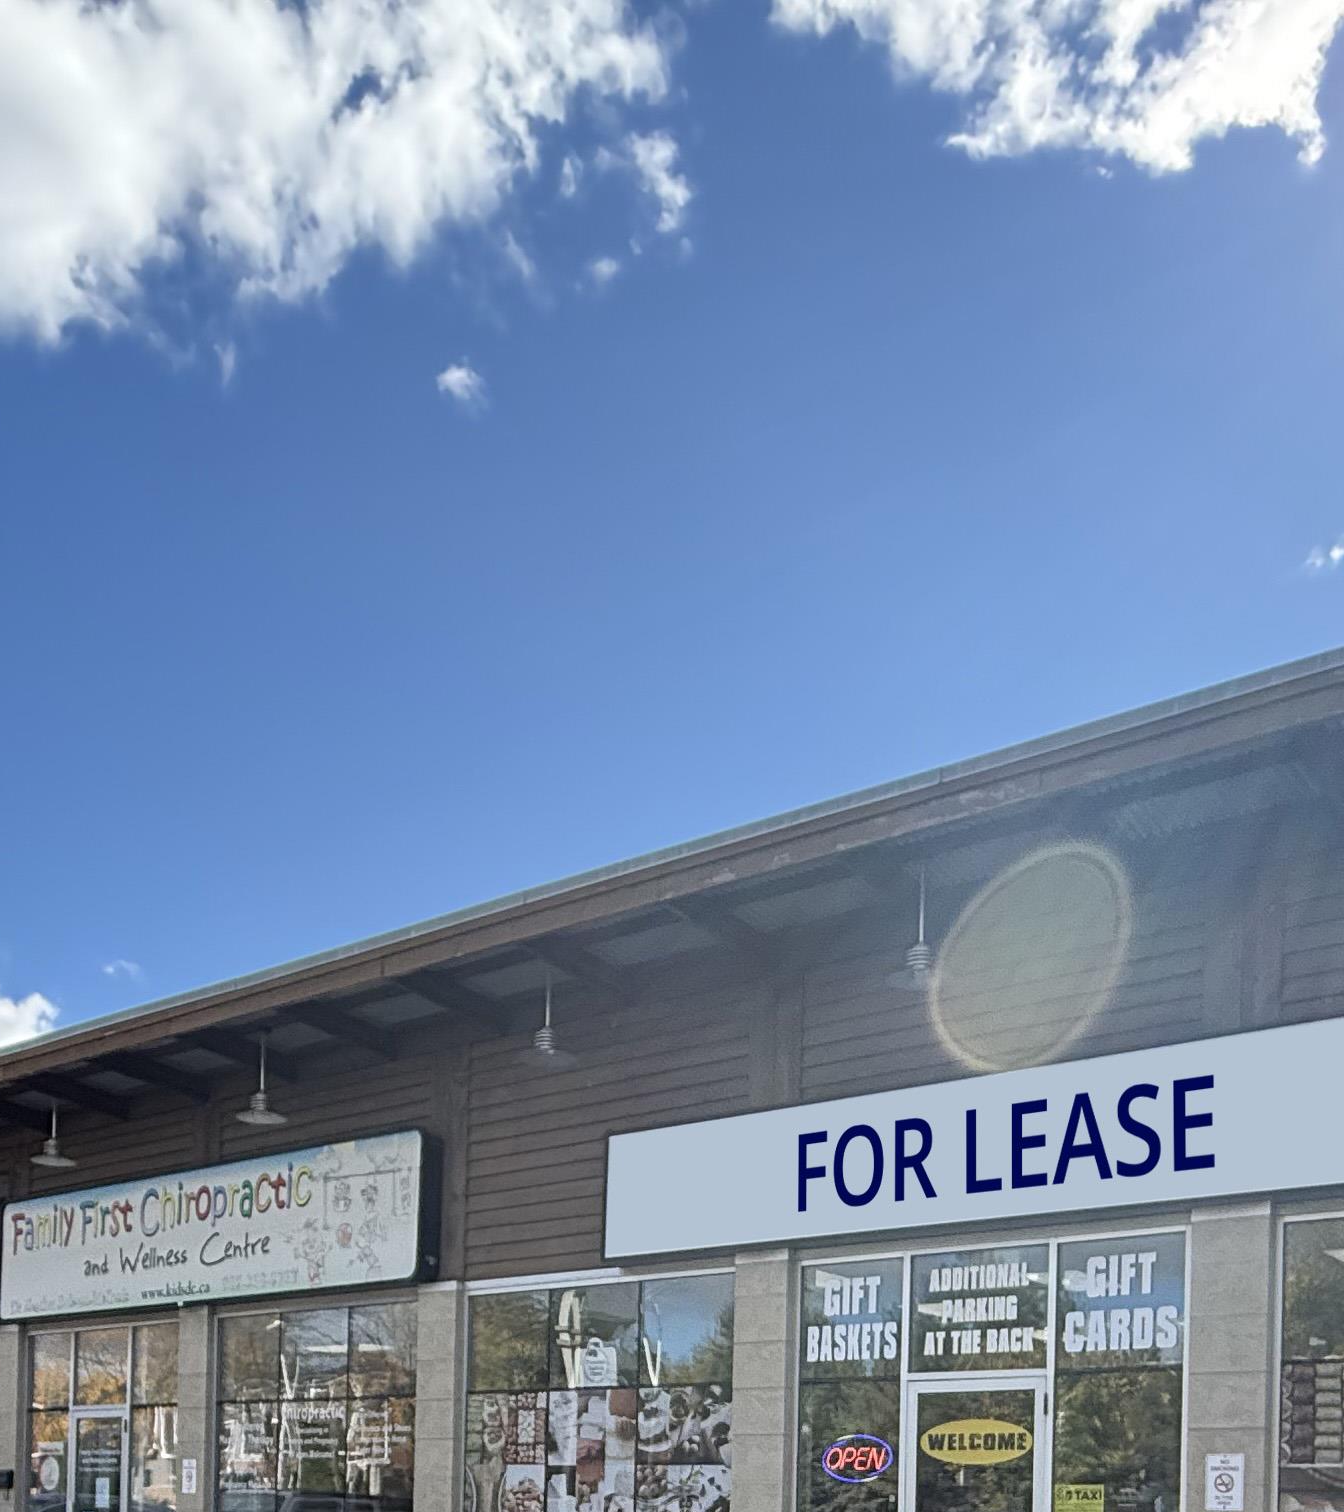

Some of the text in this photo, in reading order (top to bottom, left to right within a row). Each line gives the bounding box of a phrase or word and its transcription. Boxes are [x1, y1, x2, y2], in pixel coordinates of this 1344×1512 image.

[798, 1075, 1215, 1212] FOR LEASE
[11, 1162, 312, 1255] Family First Chiropractic
[84, 1232, 270, 1276] and Wellness Centre
[929, 1262, 1029, 1292] ADDITIONAL
[1086, 1252, 1157, 1298] GIFT
[823, 1276, 880, 1317] GIFT
[942, 1295, 1018, 1323] PARKING
[806, 1321, 897, 1362] BASKETS
[924, 1327, 1034, 1356] AT THE BACK
[1063, 1305, 1178, 1353] CARDS
[826, 1446, 886, 1471] OPEN
[927, 1432, 1027, 1451] WELCOME
